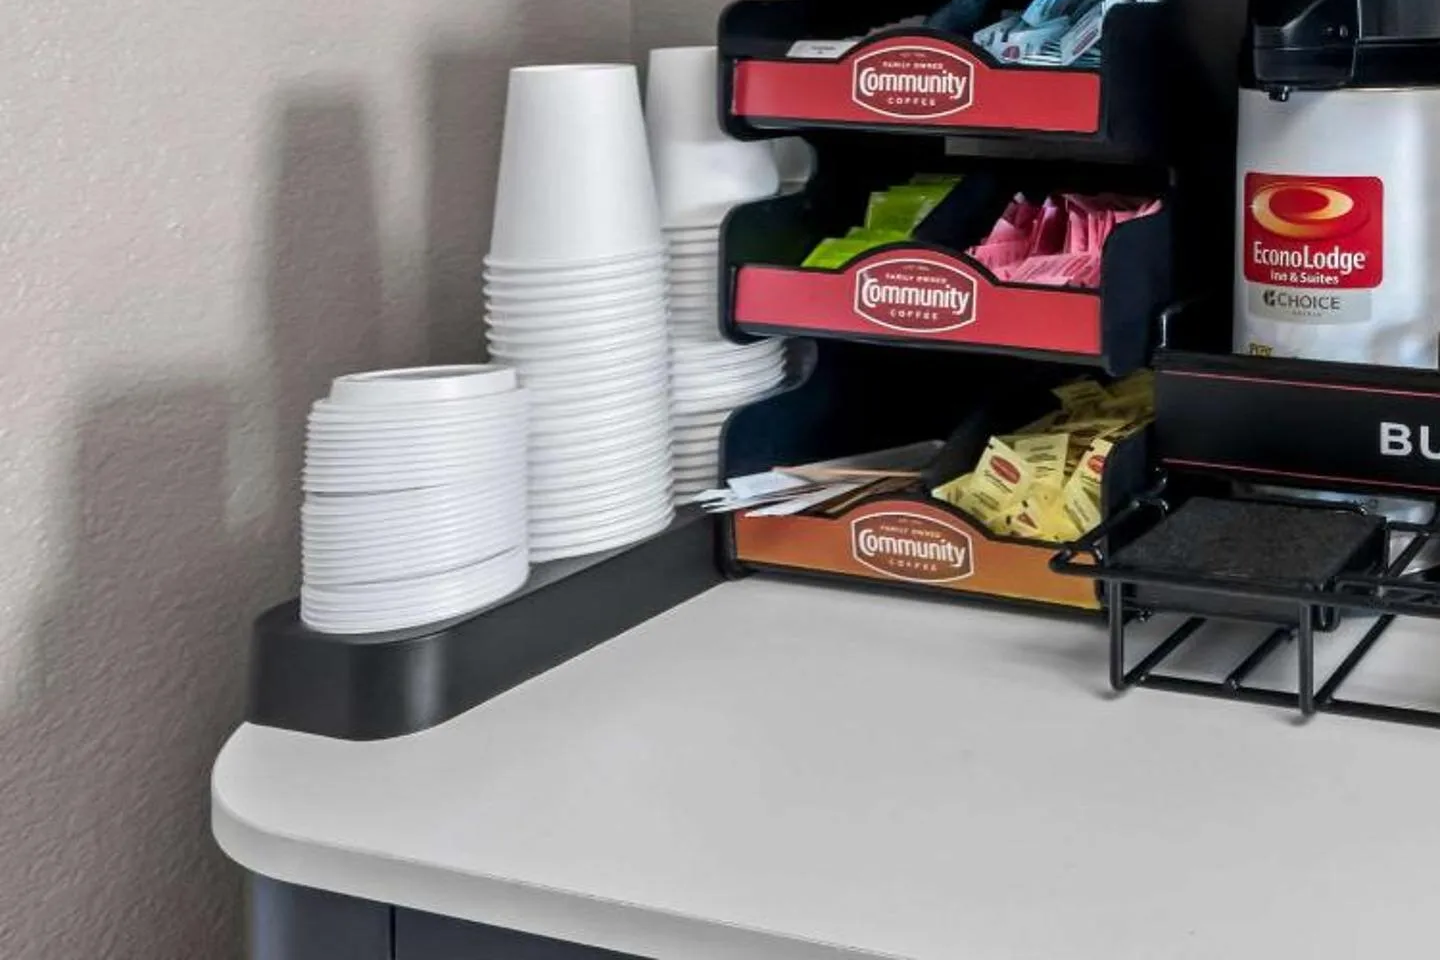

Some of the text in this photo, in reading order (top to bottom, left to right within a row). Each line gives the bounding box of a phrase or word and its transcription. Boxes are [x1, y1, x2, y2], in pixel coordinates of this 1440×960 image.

[860, 67, 967, 100] Community
[887, 97, 937, 107] COFFEE
[1253, 241, 1366, 276] EconoLodge
[1270, 269, 1340, 286] Inn & Suites
[862, 278, 971, 316] Community
[1277, 292, 1341, 311] CHOICE
[889, 308, 939, 320] COFFEE
[858, 528, 966, 568] Community
